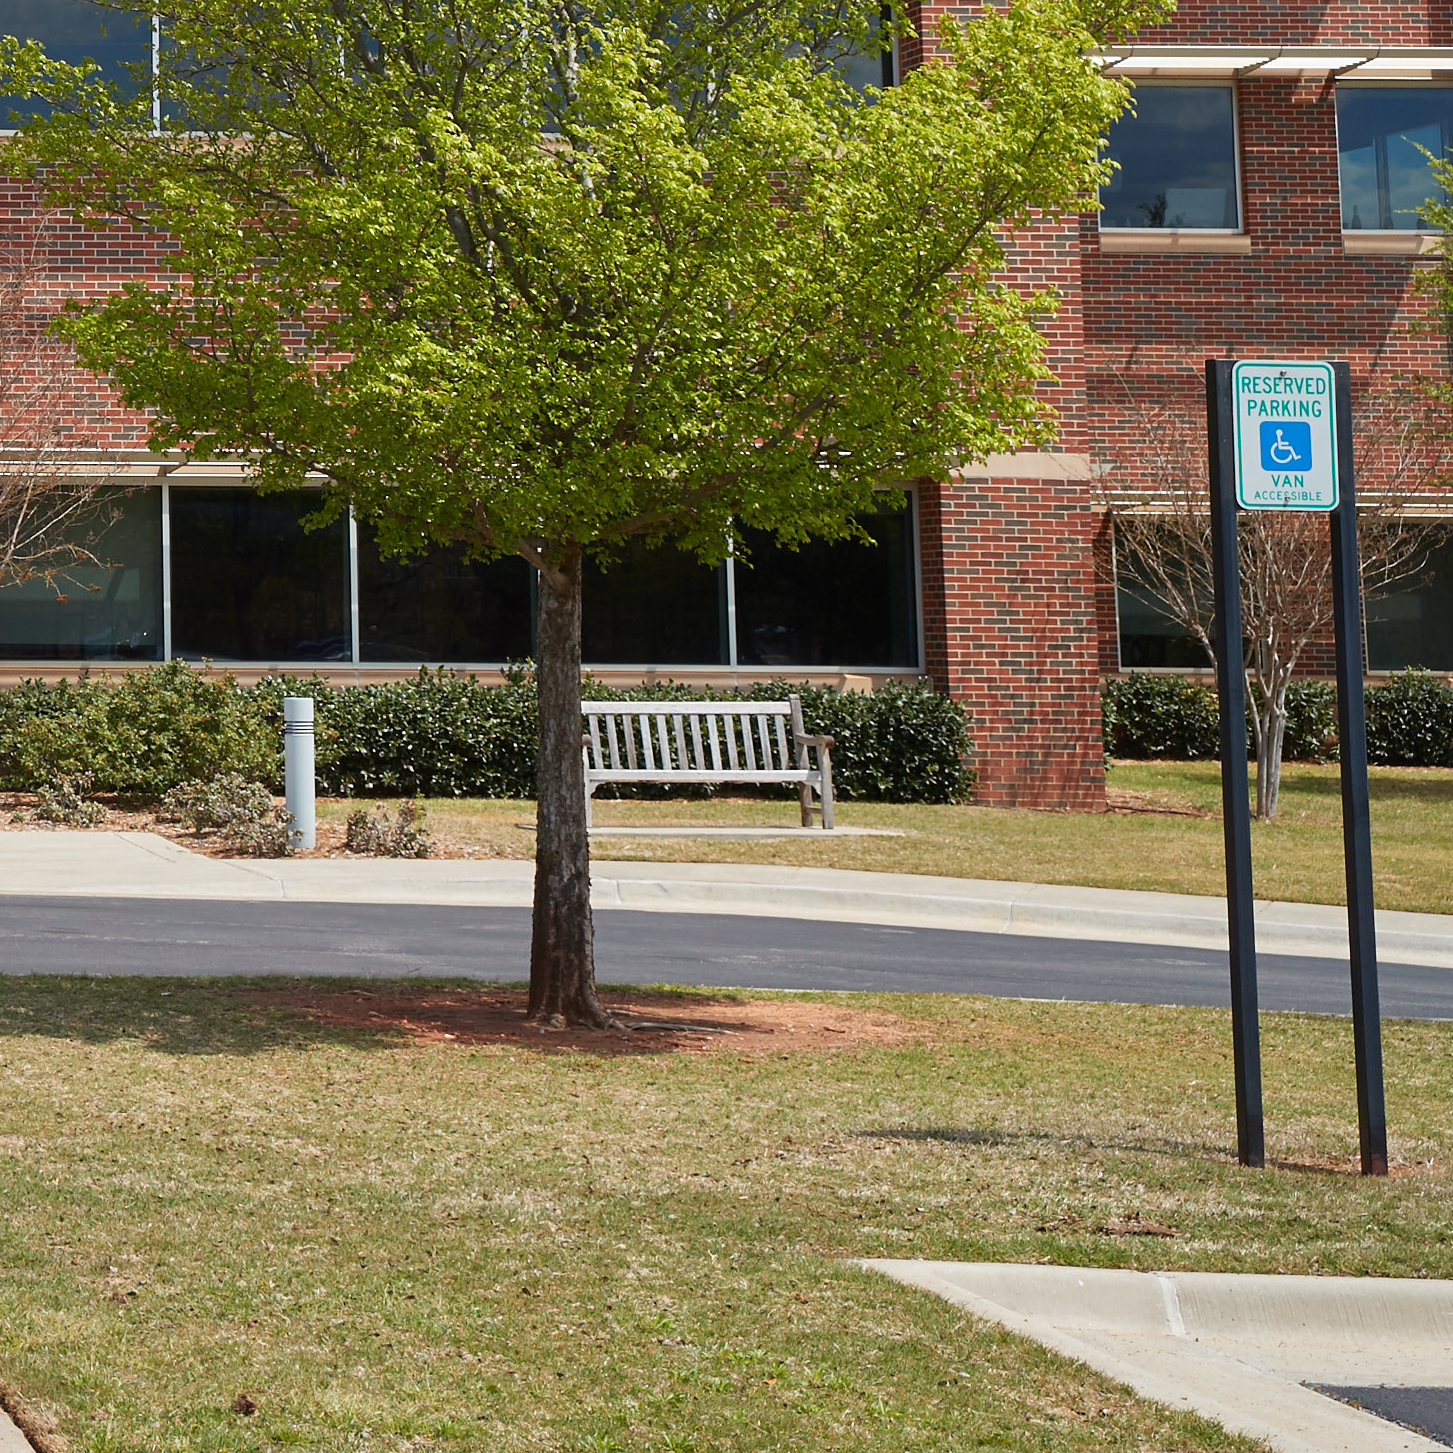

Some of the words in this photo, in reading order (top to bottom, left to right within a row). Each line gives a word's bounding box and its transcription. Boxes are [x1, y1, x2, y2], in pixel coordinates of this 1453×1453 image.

[1241, 376, 1327, 395] RESERVED
[1247, 399, 1323, 418] PARKING
[1271, 474, 1304, 488] VAN
[1254, 490, 1323, 501] ACCESSIBLE
